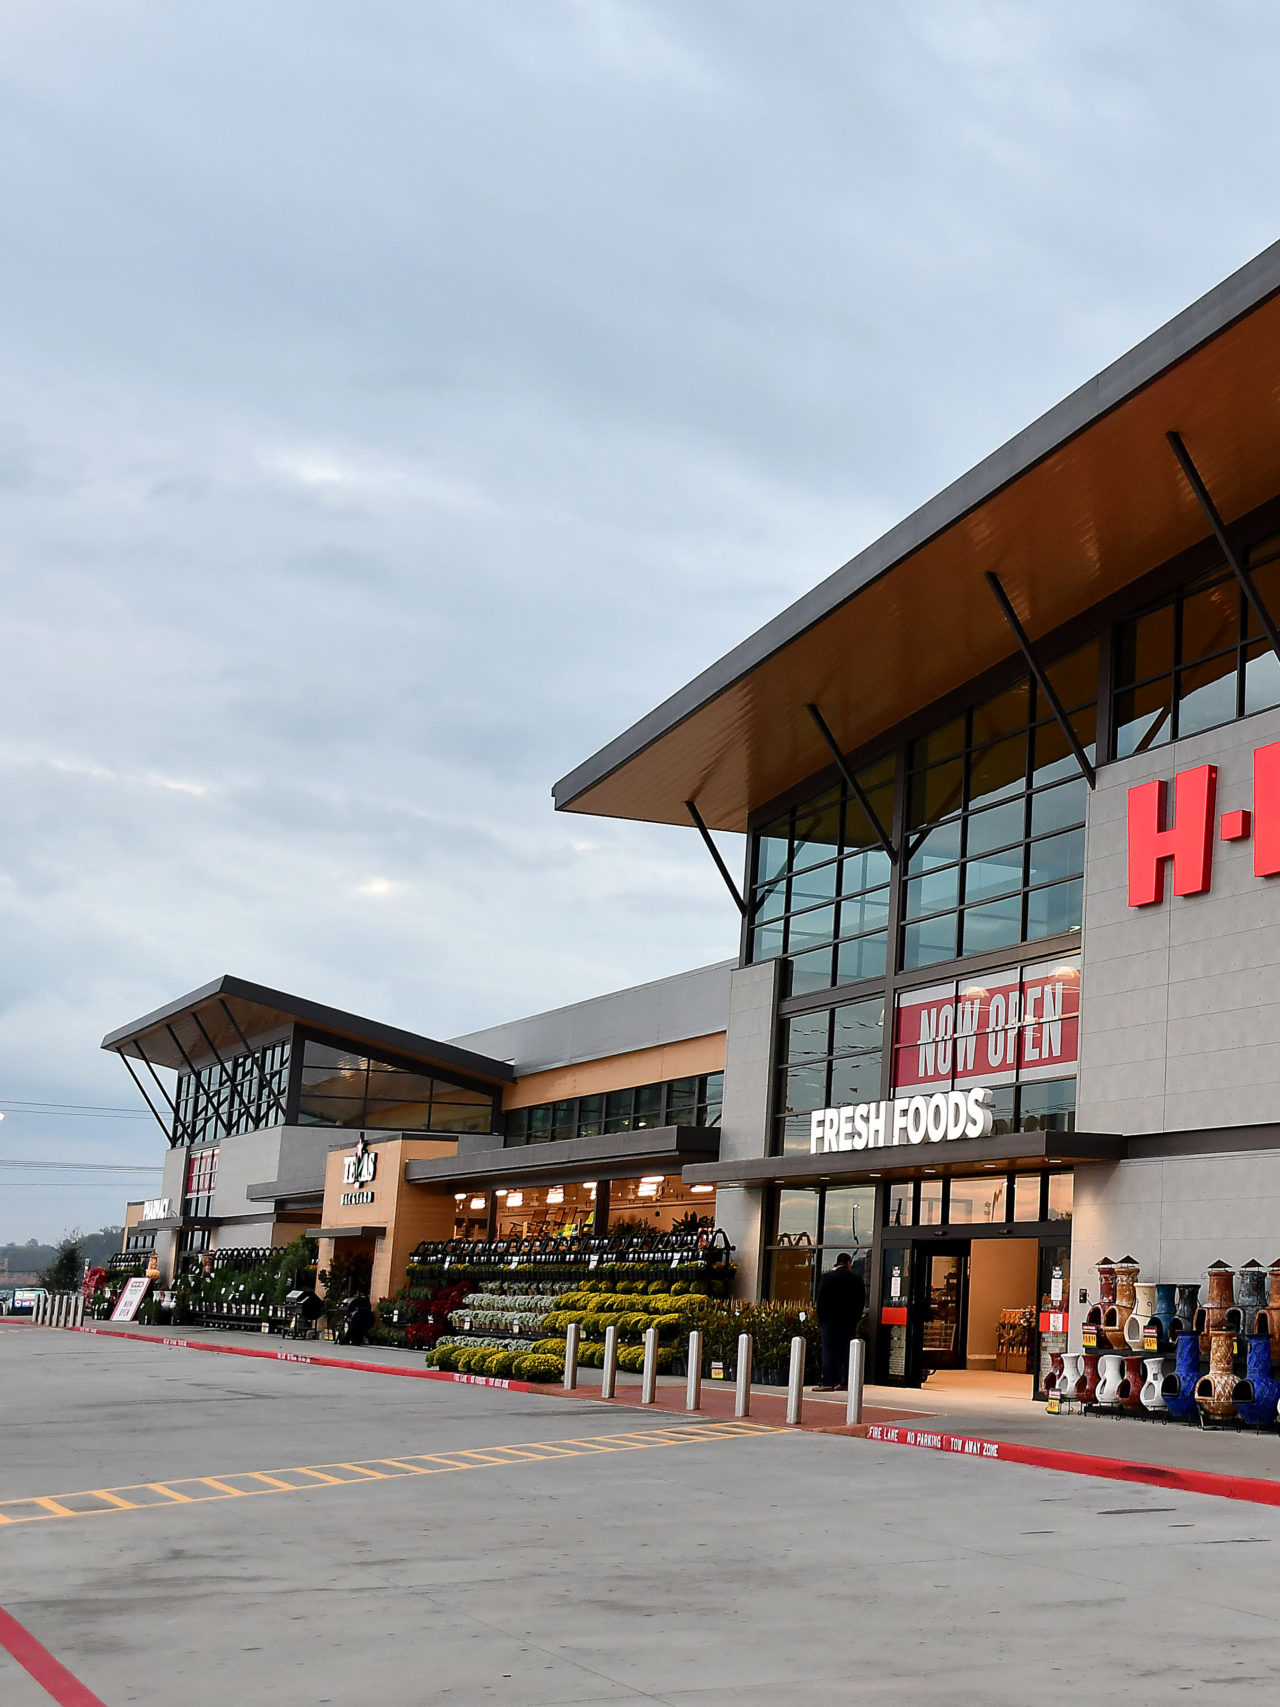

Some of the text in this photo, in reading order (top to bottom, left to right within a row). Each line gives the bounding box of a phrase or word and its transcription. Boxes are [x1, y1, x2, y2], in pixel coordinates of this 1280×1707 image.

[917, 982, 1063, 1077] NOW OPEN
[810, 1088, 993, 1154] FRESH FOODS
[869, 1426, 998, 1456] FIRE LANE NO PARKING TOW AWAY ZONE
